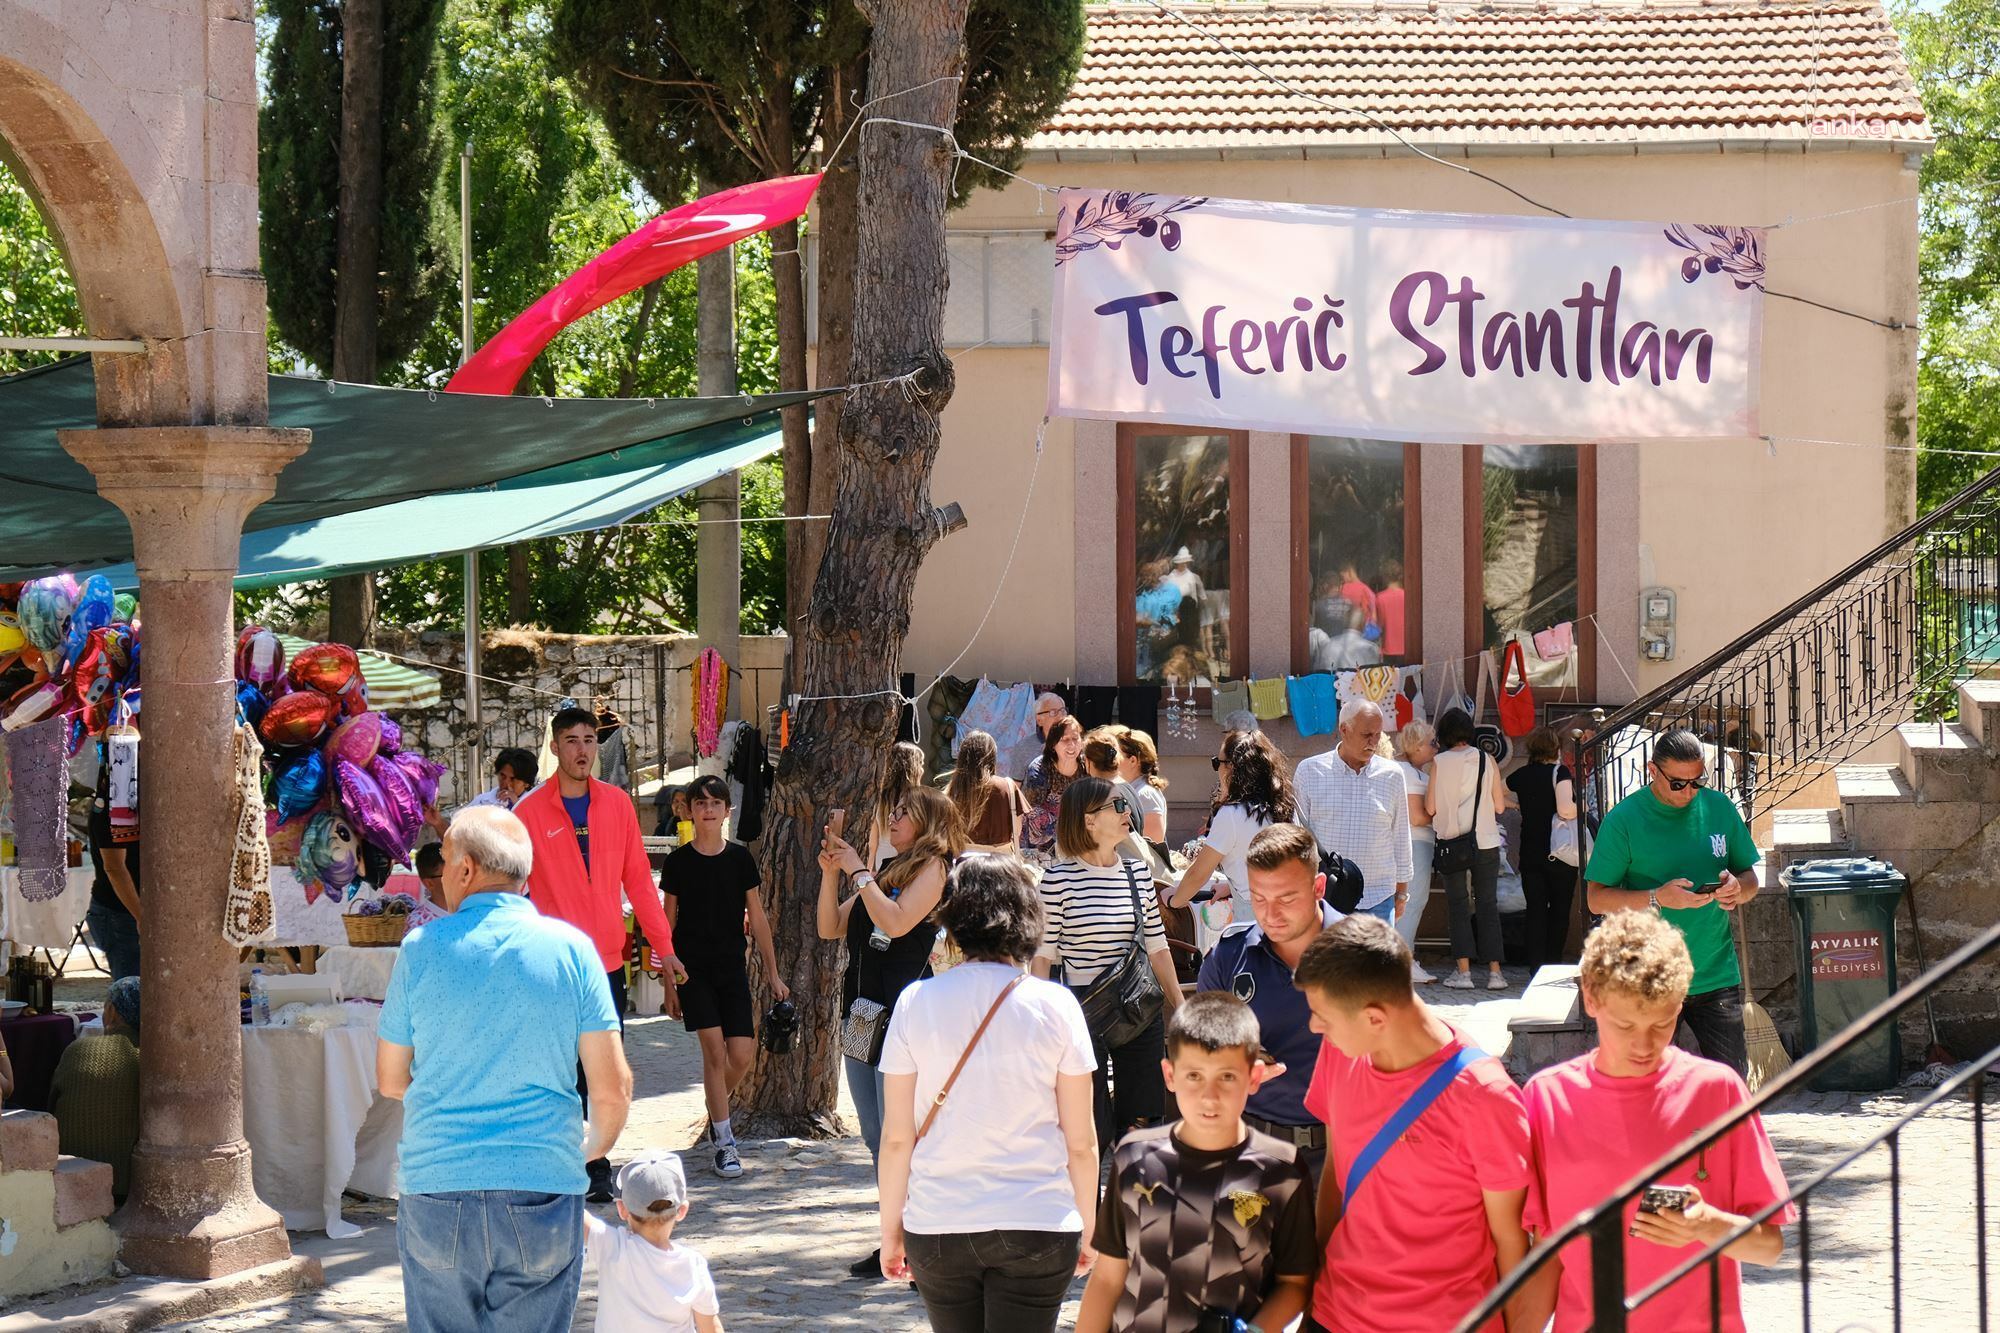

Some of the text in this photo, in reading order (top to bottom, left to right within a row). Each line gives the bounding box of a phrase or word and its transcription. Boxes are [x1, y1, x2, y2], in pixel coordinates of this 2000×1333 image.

[1094, 265, 1713, 399] Teferič Stantları
[1811, 937, 1879, 950] AYVALIK
[1812, 961, 1881, 974] BELEDİYESİ
